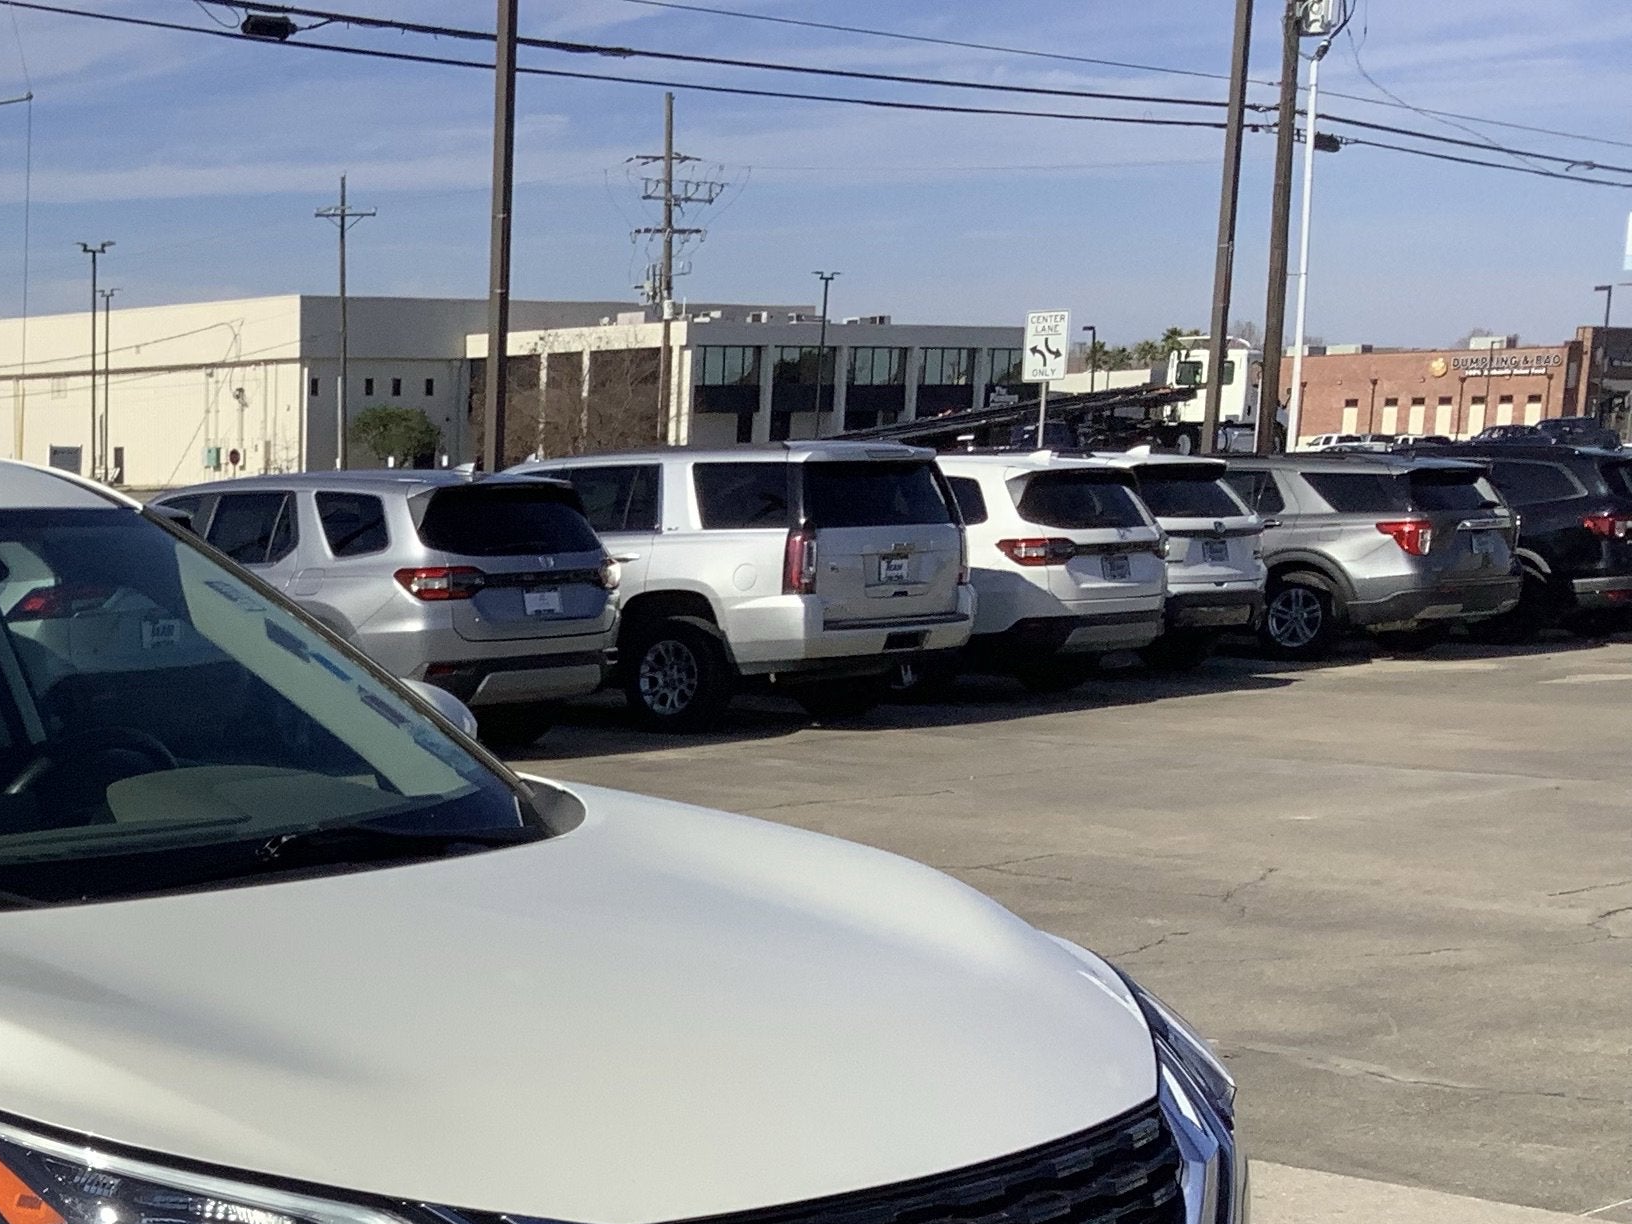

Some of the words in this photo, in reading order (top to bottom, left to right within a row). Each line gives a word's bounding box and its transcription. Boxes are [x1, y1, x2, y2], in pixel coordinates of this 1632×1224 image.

[1030, 314, 1066, 325] CENTER
[1034, 324, 1061, 334] LANE
[1535, 353, 1562, 366] BAO
[1031, 368, 1057, 378] ONLY
